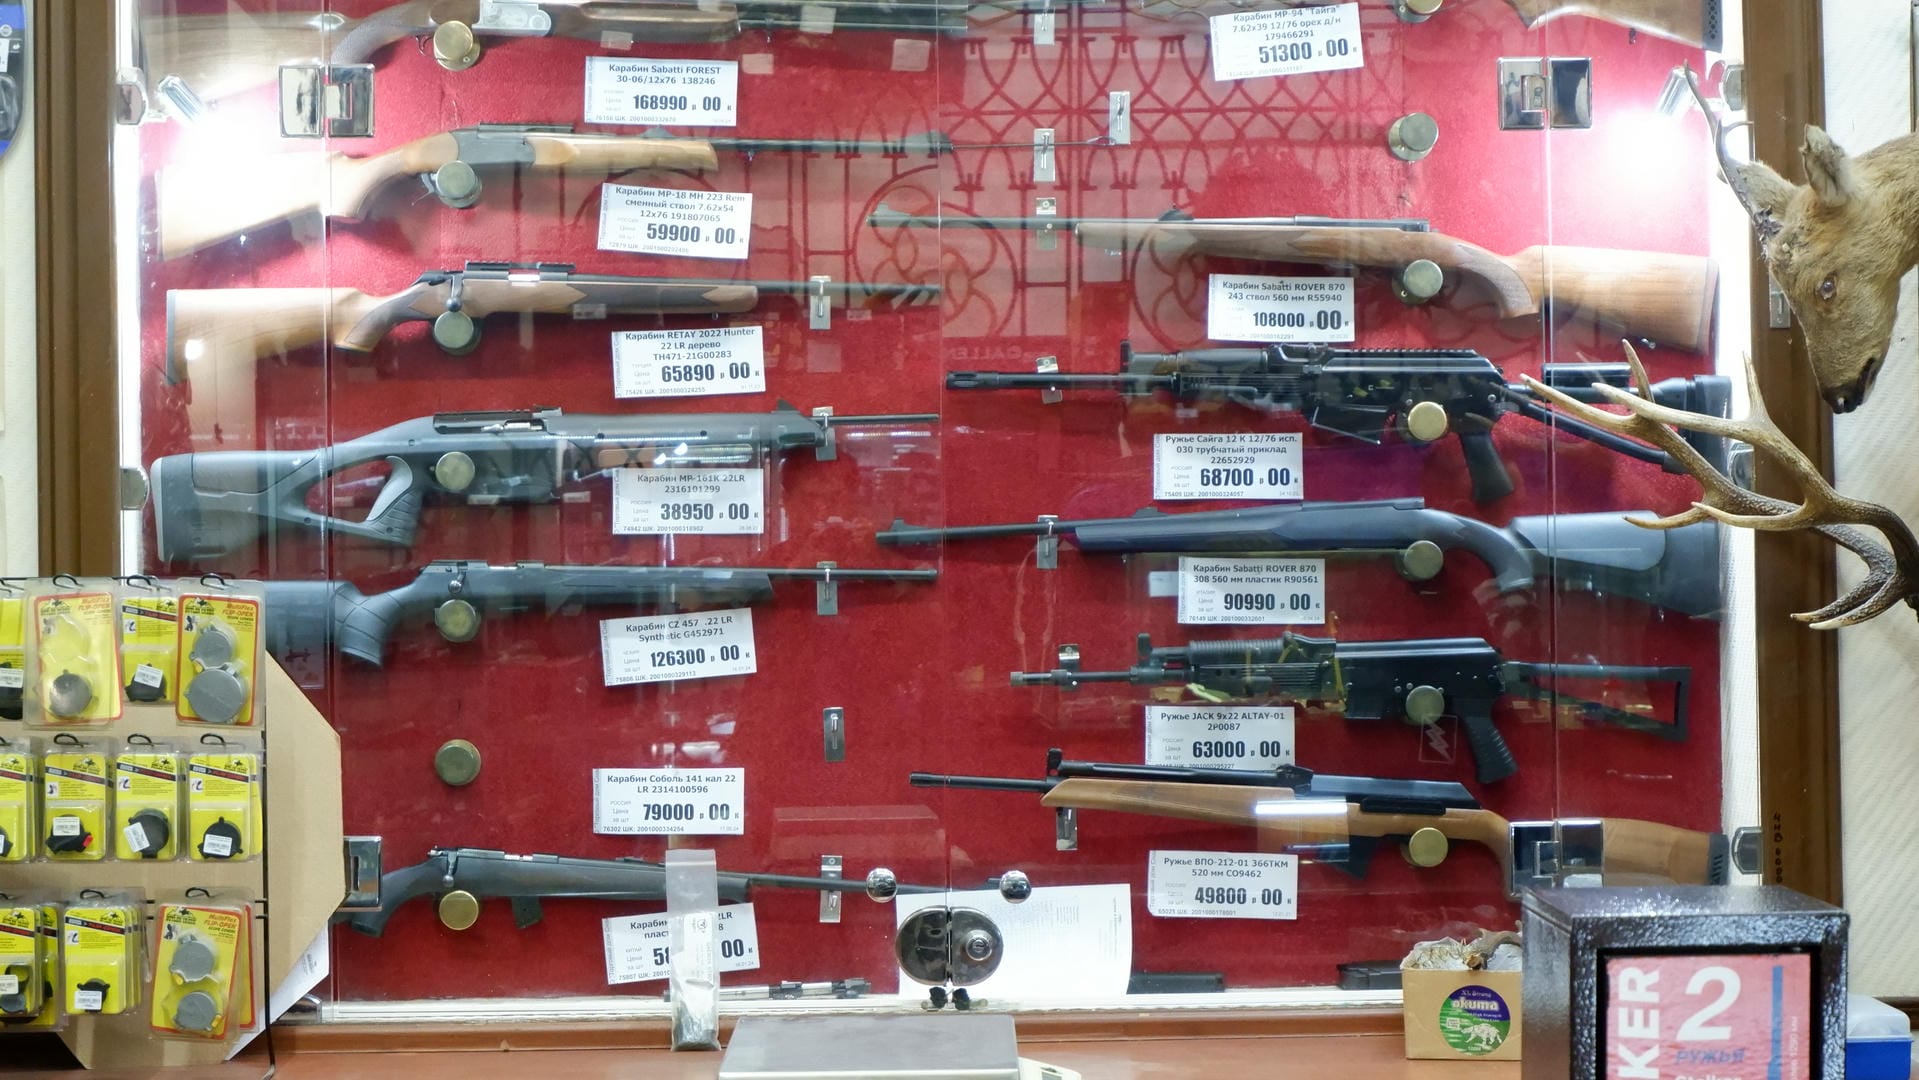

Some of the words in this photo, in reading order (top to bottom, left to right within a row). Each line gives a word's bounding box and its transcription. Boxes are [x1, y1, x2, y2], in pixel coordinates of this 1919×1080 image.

[1234, 13, 1272, 23] Карабин
[1271, 21, 1297, 29] 12/76
[1265, 30, 1314, 40] 179466291
[1259, 42, 1312, 63] 51300
[1326, 38, 1348, 57] 00
[609, 64, 648, 73] Карабин
[651, 65, 683, 74] Sabatti
[686, 66, 721, 74] FOREST
[633, 95, 687, 110] 168990
[703, 96, 721, 111] 00
[616, 187, 655, 196] Карабин
[626, 200, 667, 208] сменный
[671, 213, 720, 222] 191807065
[647, 223, 700, 242] 59900
[715, 228, 735, 244] 00
[1223, 281, 1259, 290] Карабин
[1262, 283, 1292, 291] Sabatti
[1228, 292, 1243, 300] 243
[1253, 312, 1304, 327] 108000
[1317, 310, 1342, 329] 00
[626, 333, 665, 341] Карабин
[668, 331, 696, 339] RETAY
[724, 328, 755, 336] Hunter
[688, 341, 720, 350] дерево
[662, 364, 714, 382] 65890
[730, 362, 750, 379] 00
[1166, 436, 1194, 445] Ружье
[1197, 435, 1223, 443] Сайга
[1250, 435, 1276, 444] 12/76
[1197, 446, 1244, 456] трубчатый
[1248, 446, 1287, 454] приклад
[638, 474, 676, 483] Карабин
[1200, 468, 1253, 486] 68700
[1268, 468, 1290, 486] 00
[661, 503, 714, 520] 38950
[728, 503, 749, 520] 00
[1193, 565, 1231, 573] Карабин
[1224, 593, 1275, 610] 90990
[1290, 593, 1310, 610] 00
[626, 623, 665, 633] Карабин
[668, 621, 680, 629] CZ
[682, 619, 699, 627] 457
[721, 616, 732, 624] LR
[684, 628, 724, 638] G452971
[651, 648, 705, 667] 126300
[720, 645, 739, 661] 00
[1161, 712, 1190, 721] Ружье
[1192, 712, 1214, 720] JACK
[1193, 741, 1245, 758] 63000
[1260, 741, 1280, 757] 00
[607, 775, 647, 784] Карабин
[650, 774, 683, 782] Соболь
[643, 804, 694, 821] 79000
[709, 804, 729, 820] 00
[1164, 857, 1192, 866] Ружье
[1195, 858, 1248, 867] ВПО-212-01
[1195, 887, 1246, 904] 49800
[1262, 888, 1282, 905] 00
[722, 939, 744, 958] 00
[1451, 996, 1499, 1011] okuma
[1675, 966, 1742, 1041] 2
